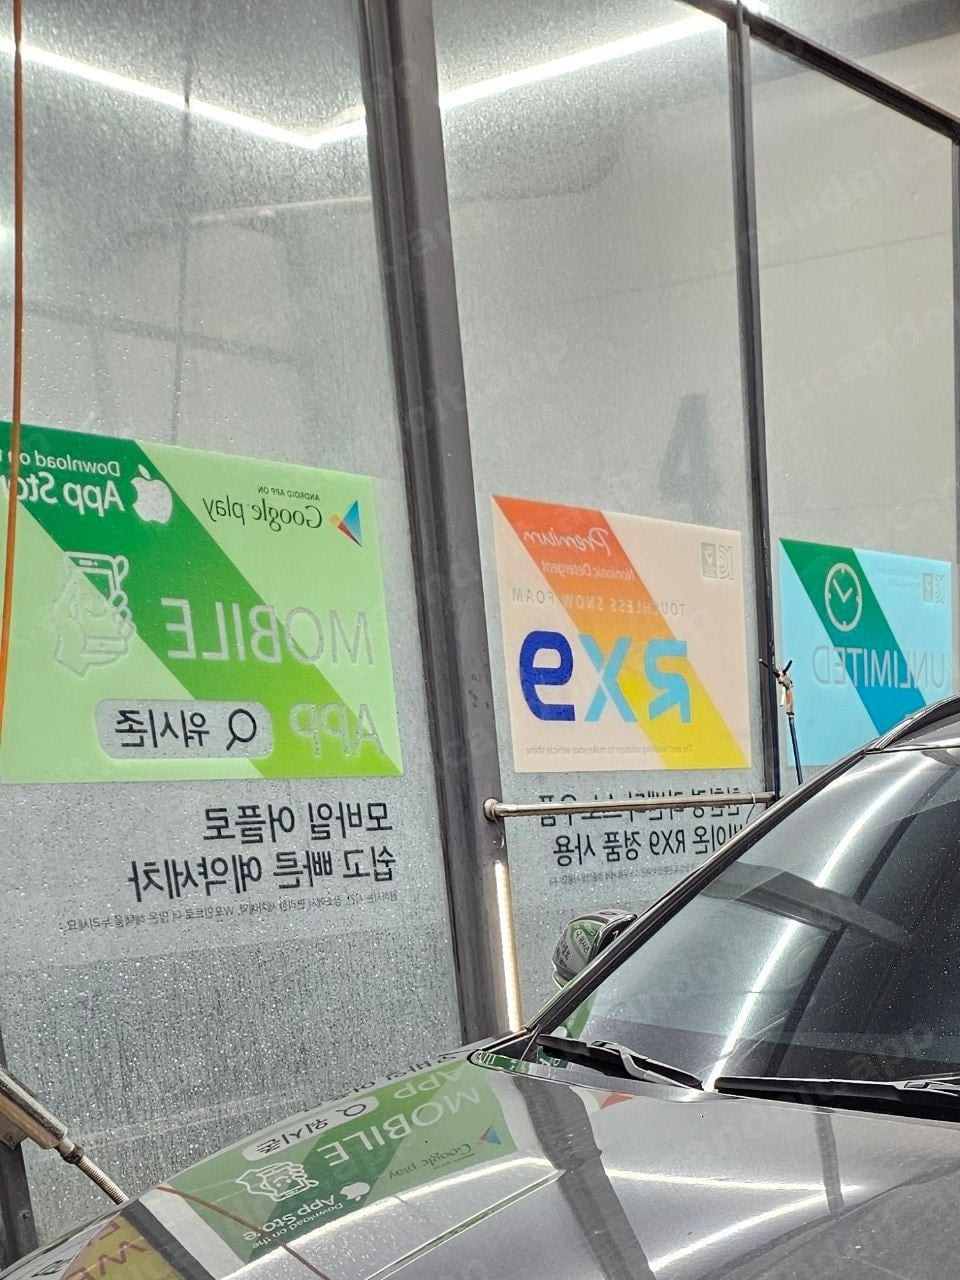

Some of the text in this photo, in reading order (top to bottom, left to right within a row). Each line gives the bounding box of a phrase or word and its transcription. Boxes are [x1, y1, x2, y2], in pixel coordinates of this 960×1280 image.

[317, 1086, 482, 1167] MOBILE
[290, 1202, 344, 1231] Download
[297, 1195, 334, 1216] App
[273, 1227, 287, 1239] on
